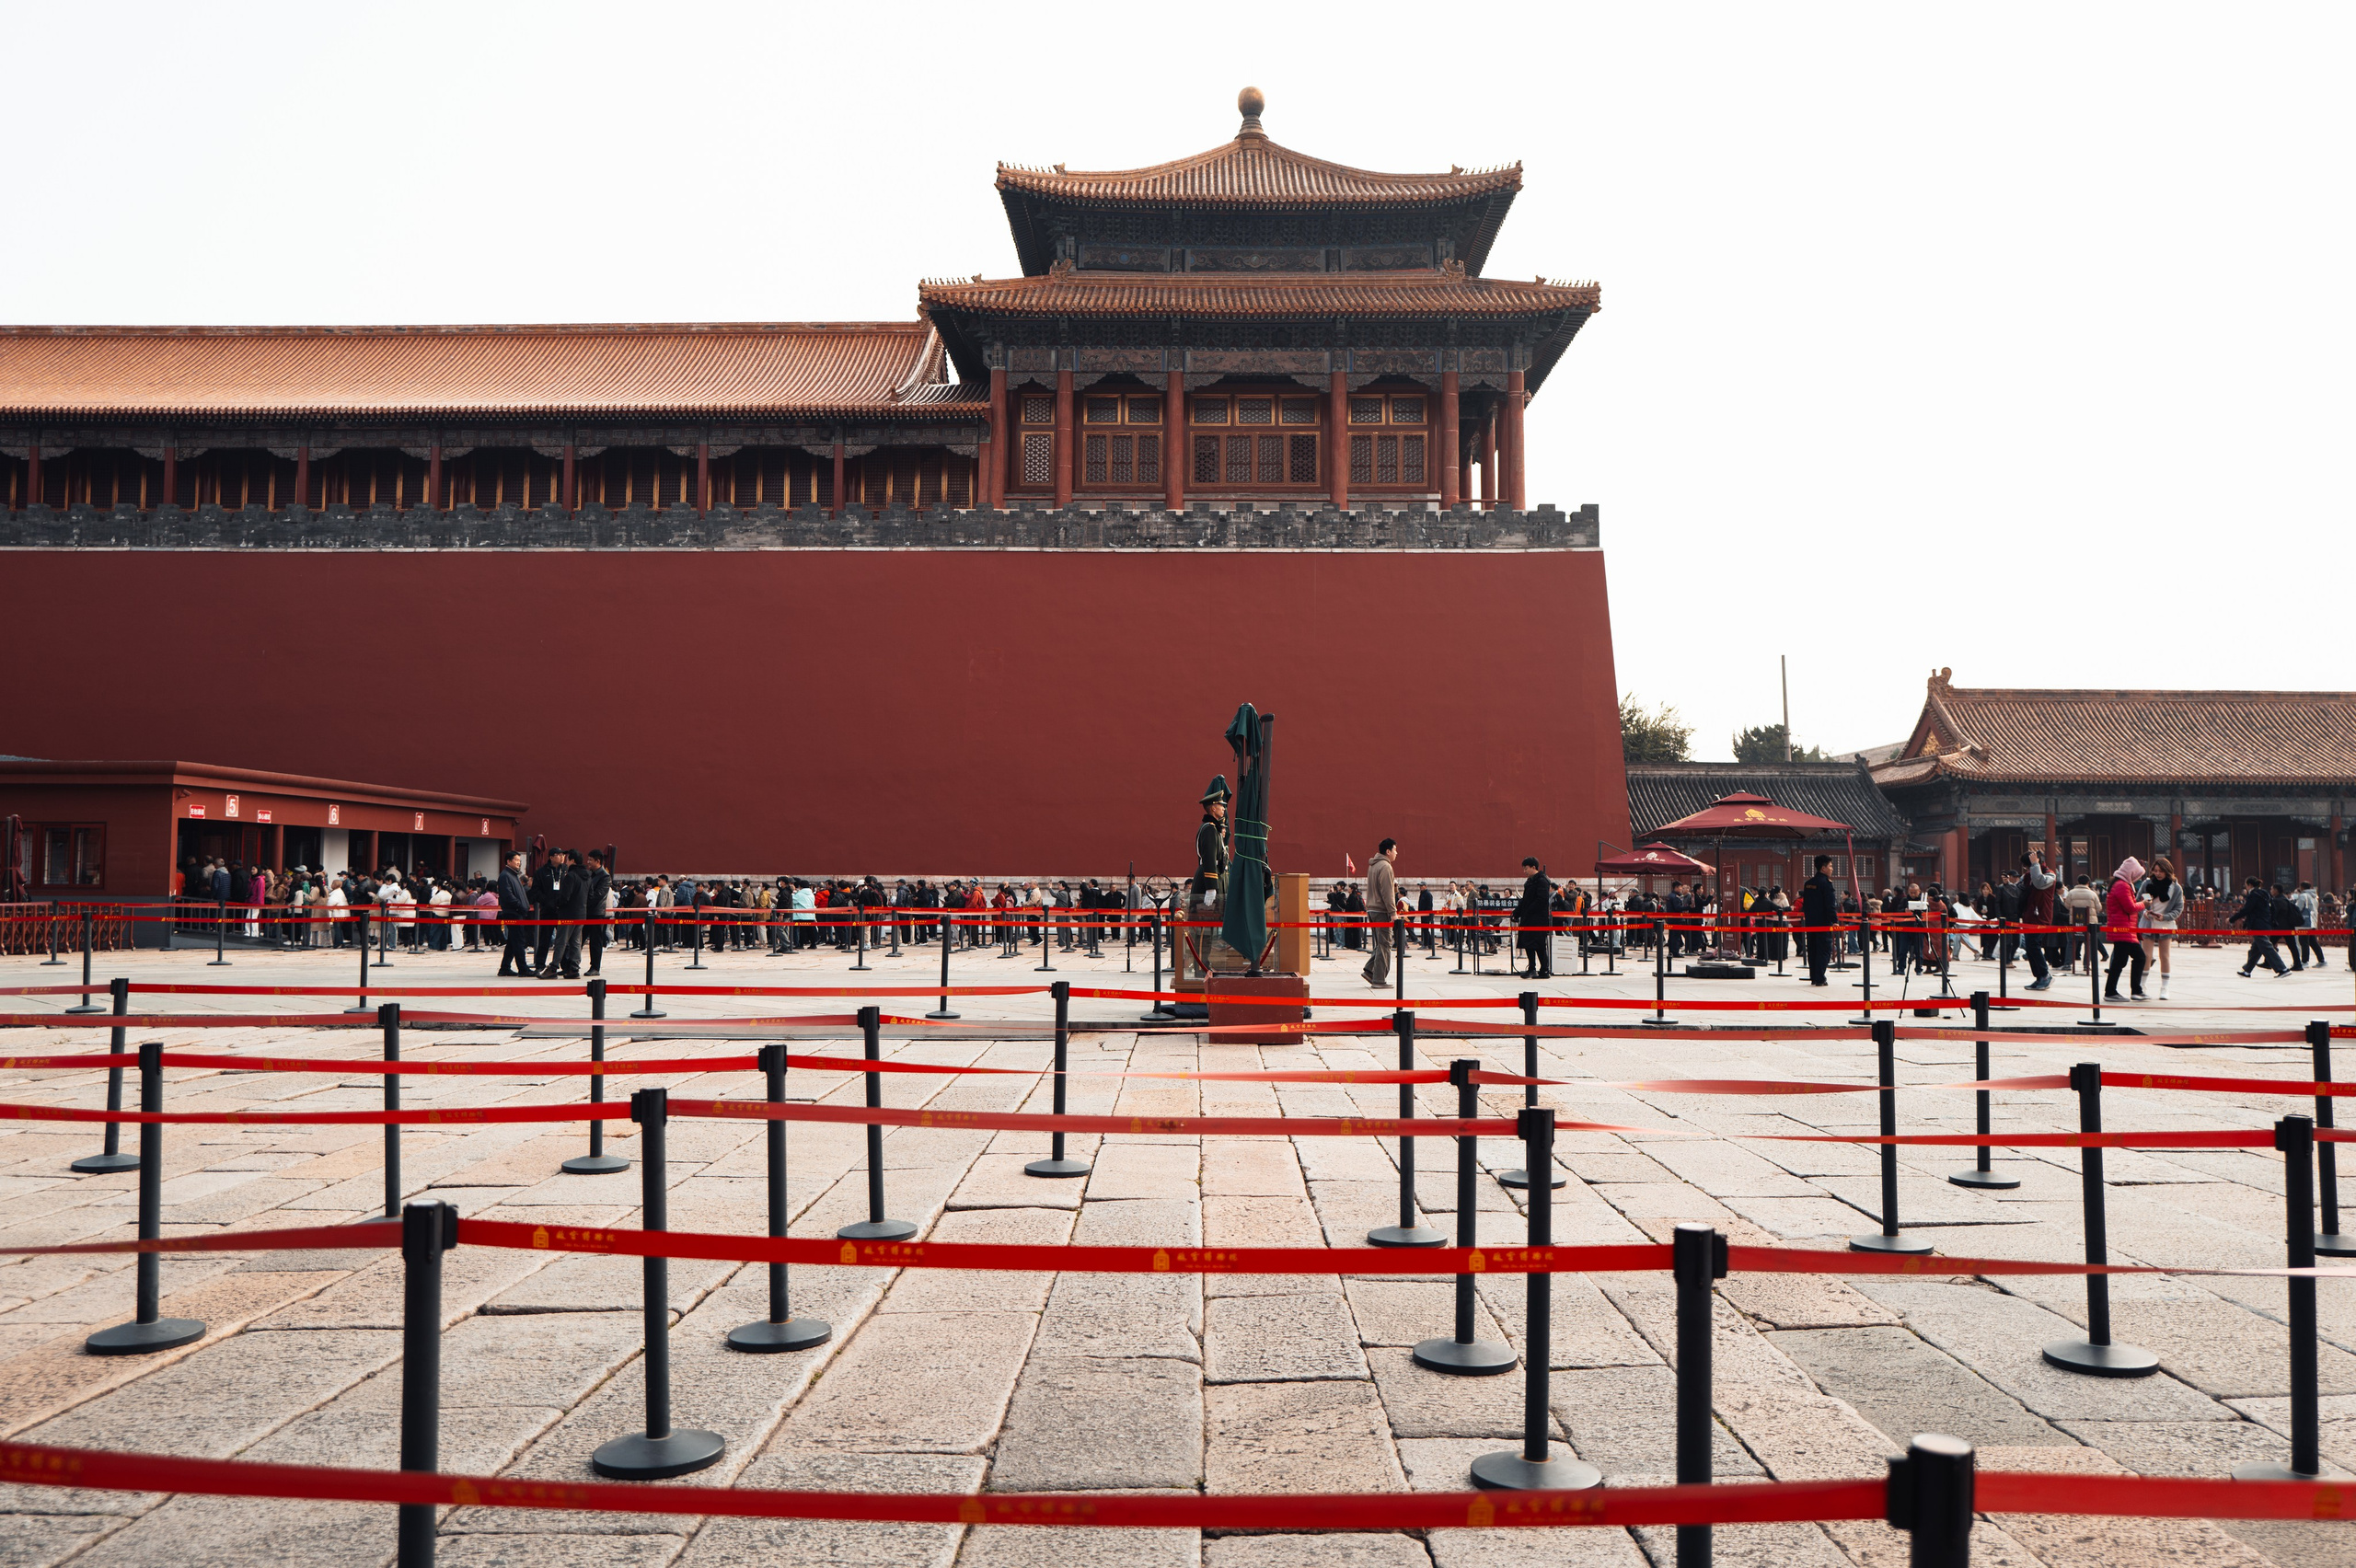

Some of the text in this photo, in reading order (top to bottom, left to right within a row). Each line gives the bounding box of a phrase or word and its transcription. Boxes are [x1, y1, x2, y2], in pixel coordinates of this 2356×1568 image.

[229, 799, 236, 813] 5
[330, 808, 337, 822] 6
[417, 815, 422, 827] 7
[483, 822, 488, 832] 8
